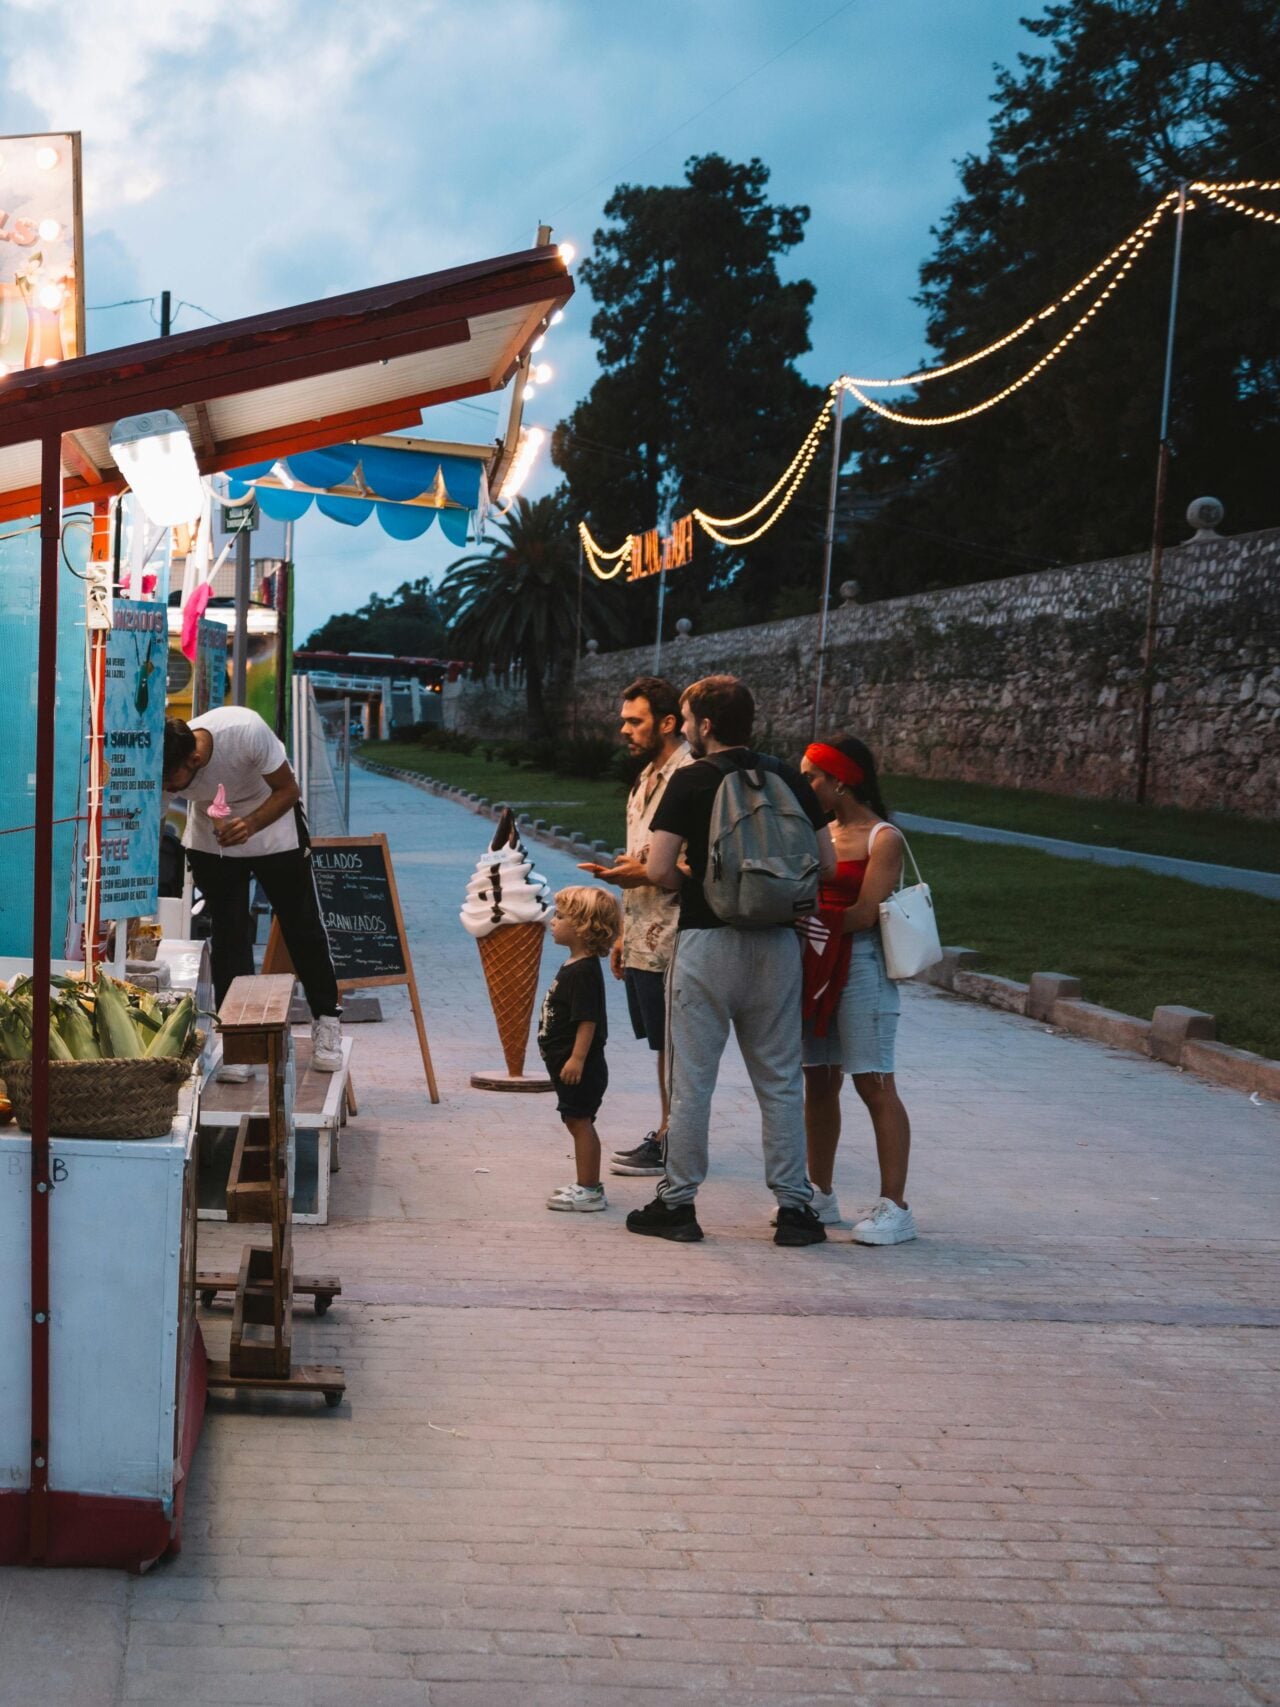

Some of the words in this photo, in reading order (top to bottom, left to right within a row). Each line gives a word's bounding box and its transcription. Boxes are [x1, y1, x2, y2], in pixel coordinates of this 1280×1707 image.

[114, 609, 163, 632] NIZADOS
[111, 730, 151, 748] SIROPES
[81, 839, 129, 862] CFEE
[311, 853, 363, 868] HELADOS
[322, 912, 387, 932] GRANIZADOS
[53, 1158, 68, 1182] B
